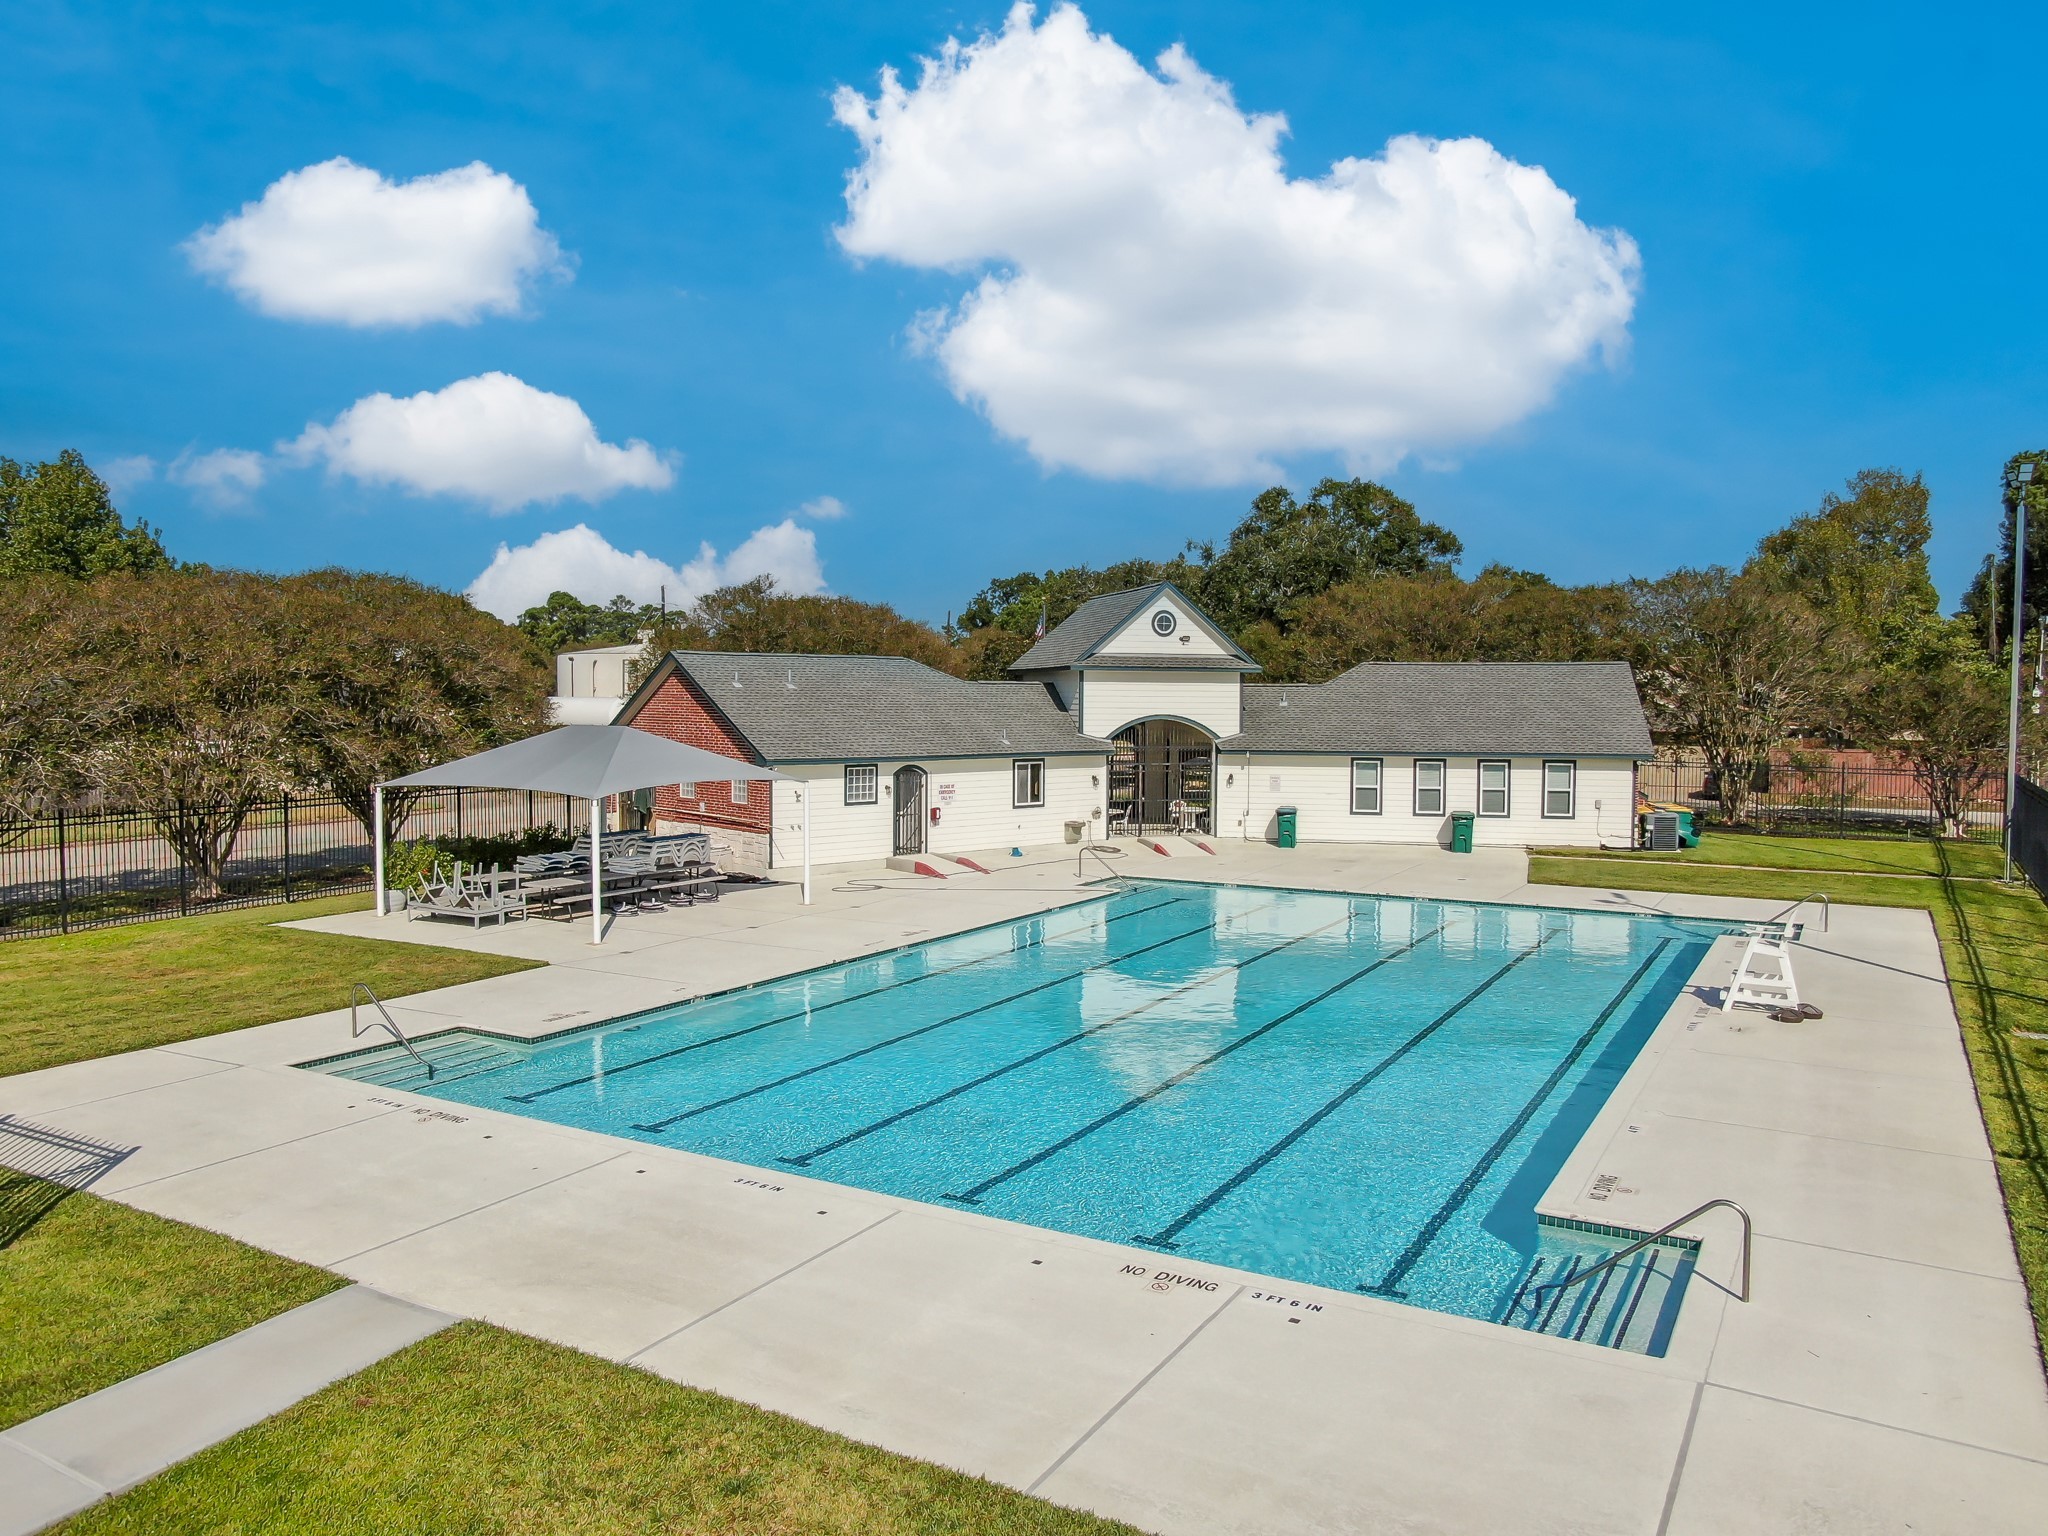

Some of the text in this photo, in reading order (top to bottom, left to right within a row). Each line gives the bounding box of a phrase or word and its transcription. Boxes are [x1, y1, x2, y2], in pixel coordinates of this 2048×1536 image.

[429, 1111, 469, 1124] DIVING
[1593, 1174, 1618, 1193] DIVING
[1120, 1264, 1219, 1292] NO DIVING
[1266, 1294, 1286, 1304] FT
[1305, 1303, 1323, 1313] IN
